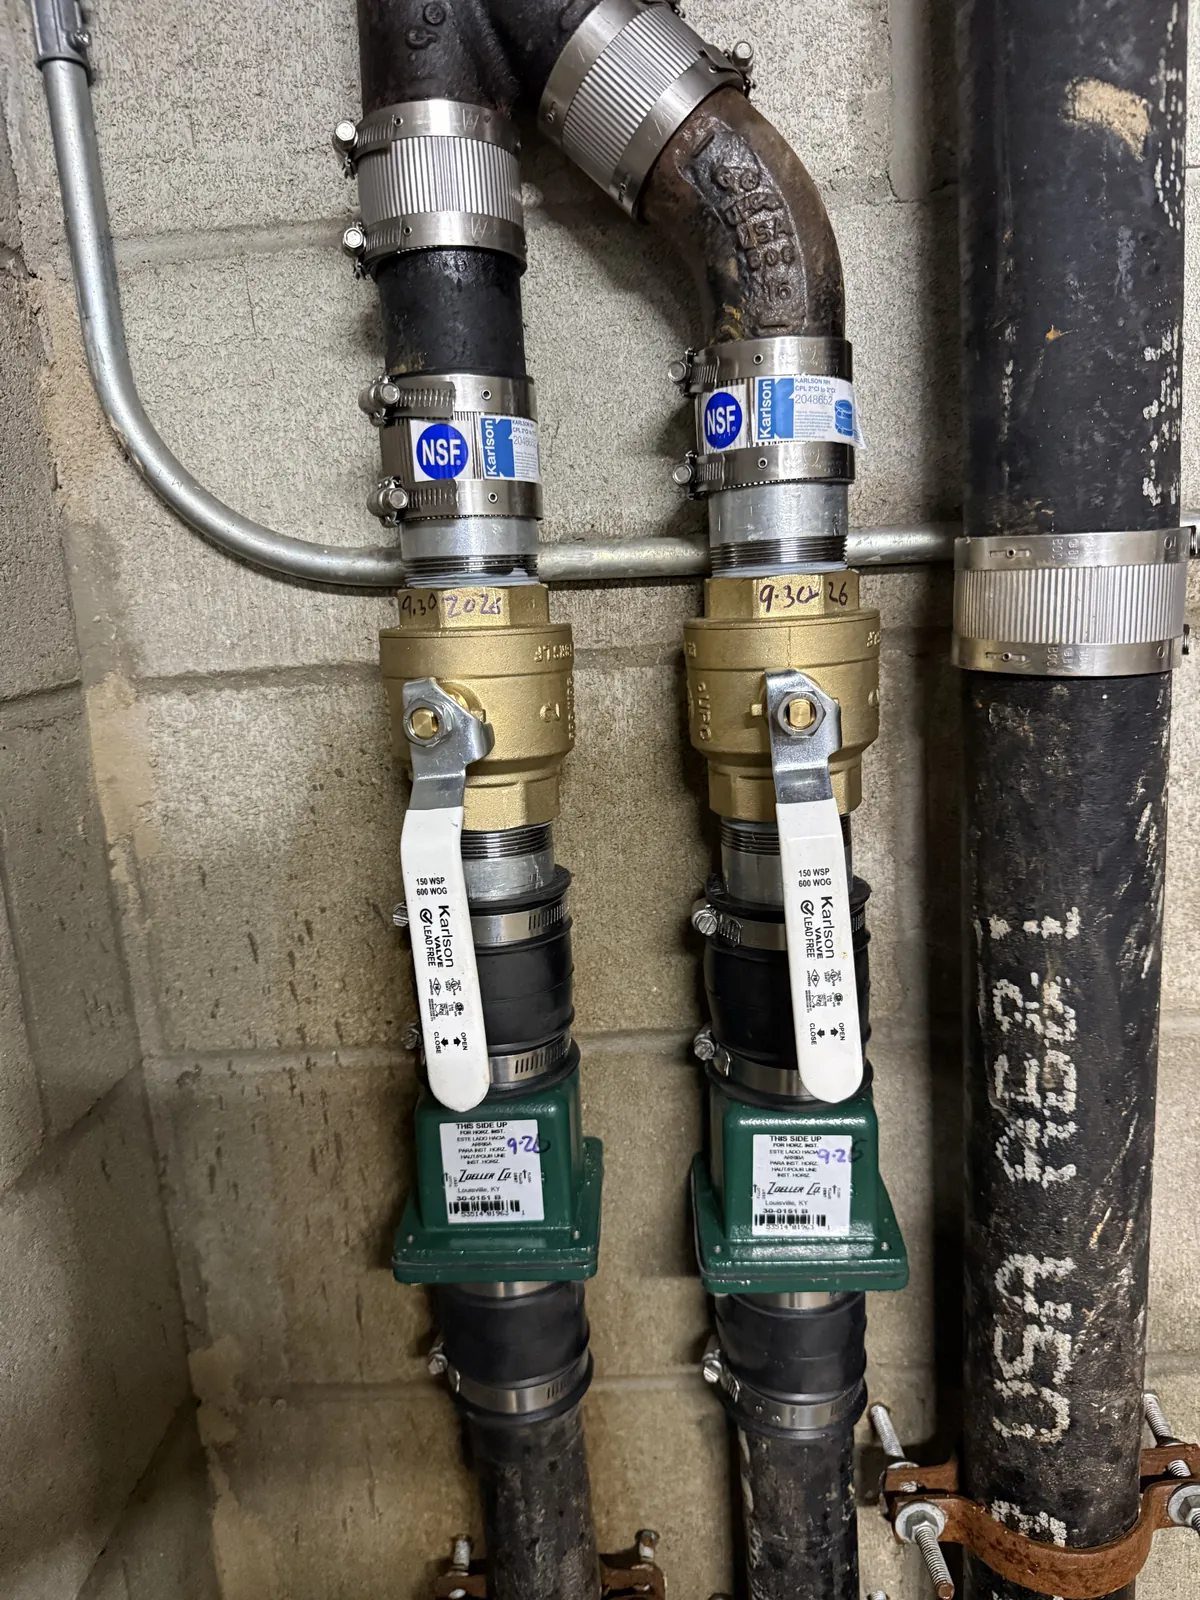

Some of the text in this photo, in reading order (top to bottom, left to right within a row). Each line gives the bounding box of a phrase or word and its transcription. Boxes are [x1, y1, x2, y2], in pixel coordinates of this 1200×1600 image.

[760, 381, 771, 437] Karlson
[795, 394, 832, 405] 2048652
[707, 405, 735, 436] NSF
[421, 438, 461, 466] NSF
[485, 420, 498, 475] Karlson
[828, 582, 848, 606] 26
[416, 877, 445, 885] 150 WSP
[798, 878, 832, 887] 600 WOG
[799, 868, 830, 877] 150 WSP
[416, 887, 448, 896] 600 WOG
[438, 905, 454, 968] Karlson
[804, 917, 815, 958] LEAD FREE
[821, 896, 835, 958] Karlson
[423, 925, 436, 966] LEAD FREE
[434, 936, 443, 968] VALVE
[815, 927, 823, 959] VALVE
[434, 1031, 442, 1054] CLOSE
[995, 1253, 1076, 1443] USA
